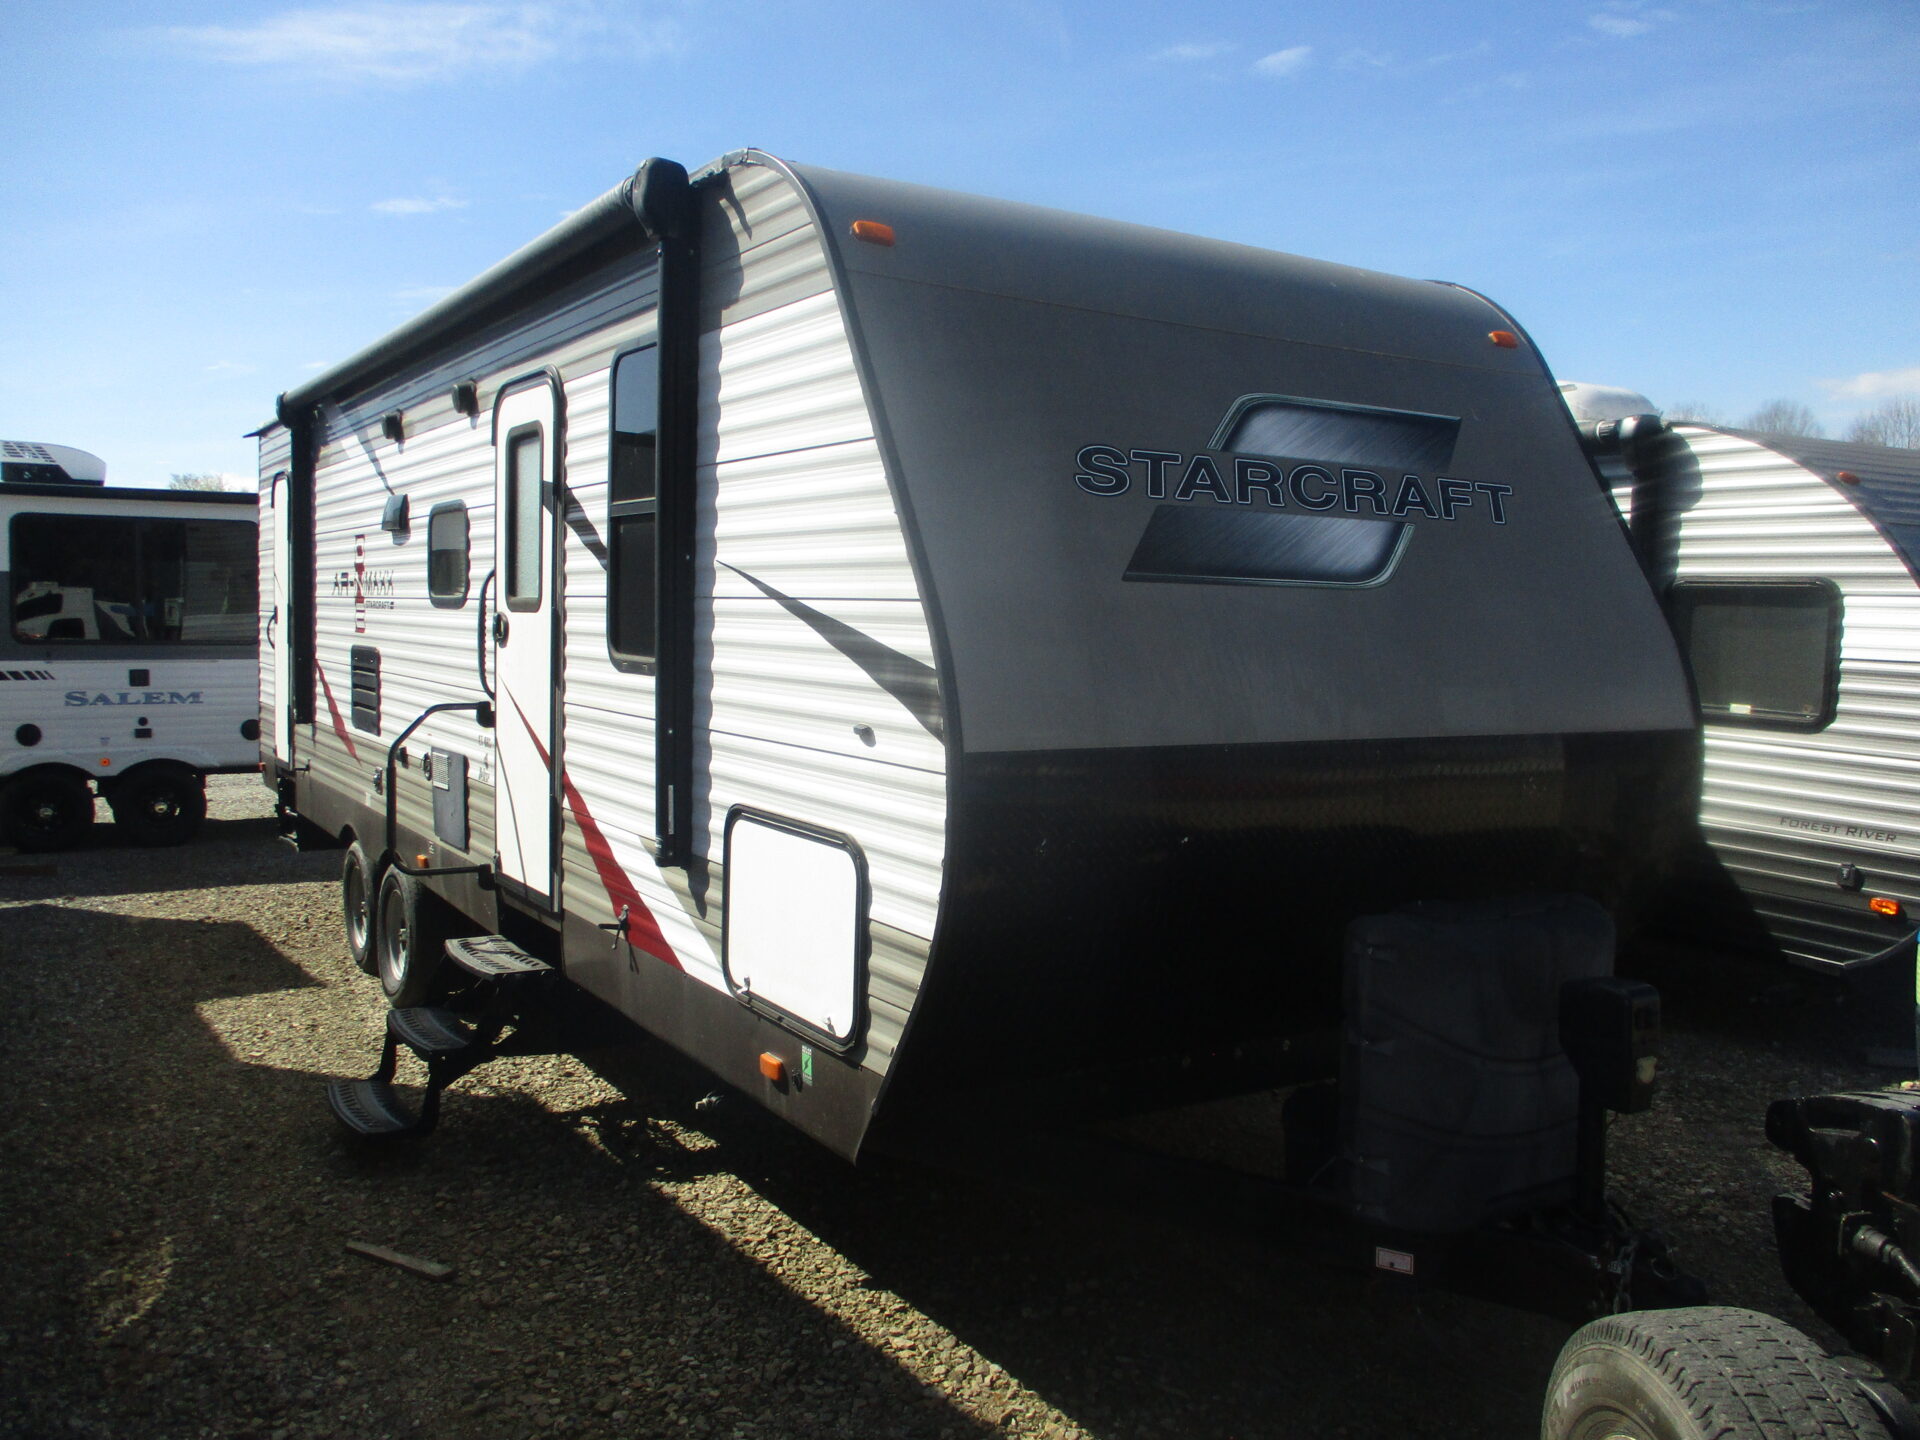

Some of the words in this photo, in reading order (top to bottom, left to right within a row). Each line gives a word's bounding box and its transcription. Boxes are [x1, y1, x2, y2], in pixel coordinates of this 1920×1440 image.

[1074, 444, 1513, 525] STARCRAFT
[64, 691, 204, 707] SALEM
[1779, 817, 1841, 834] FOREST
[1846, 826, 1897, 842] RIVER
